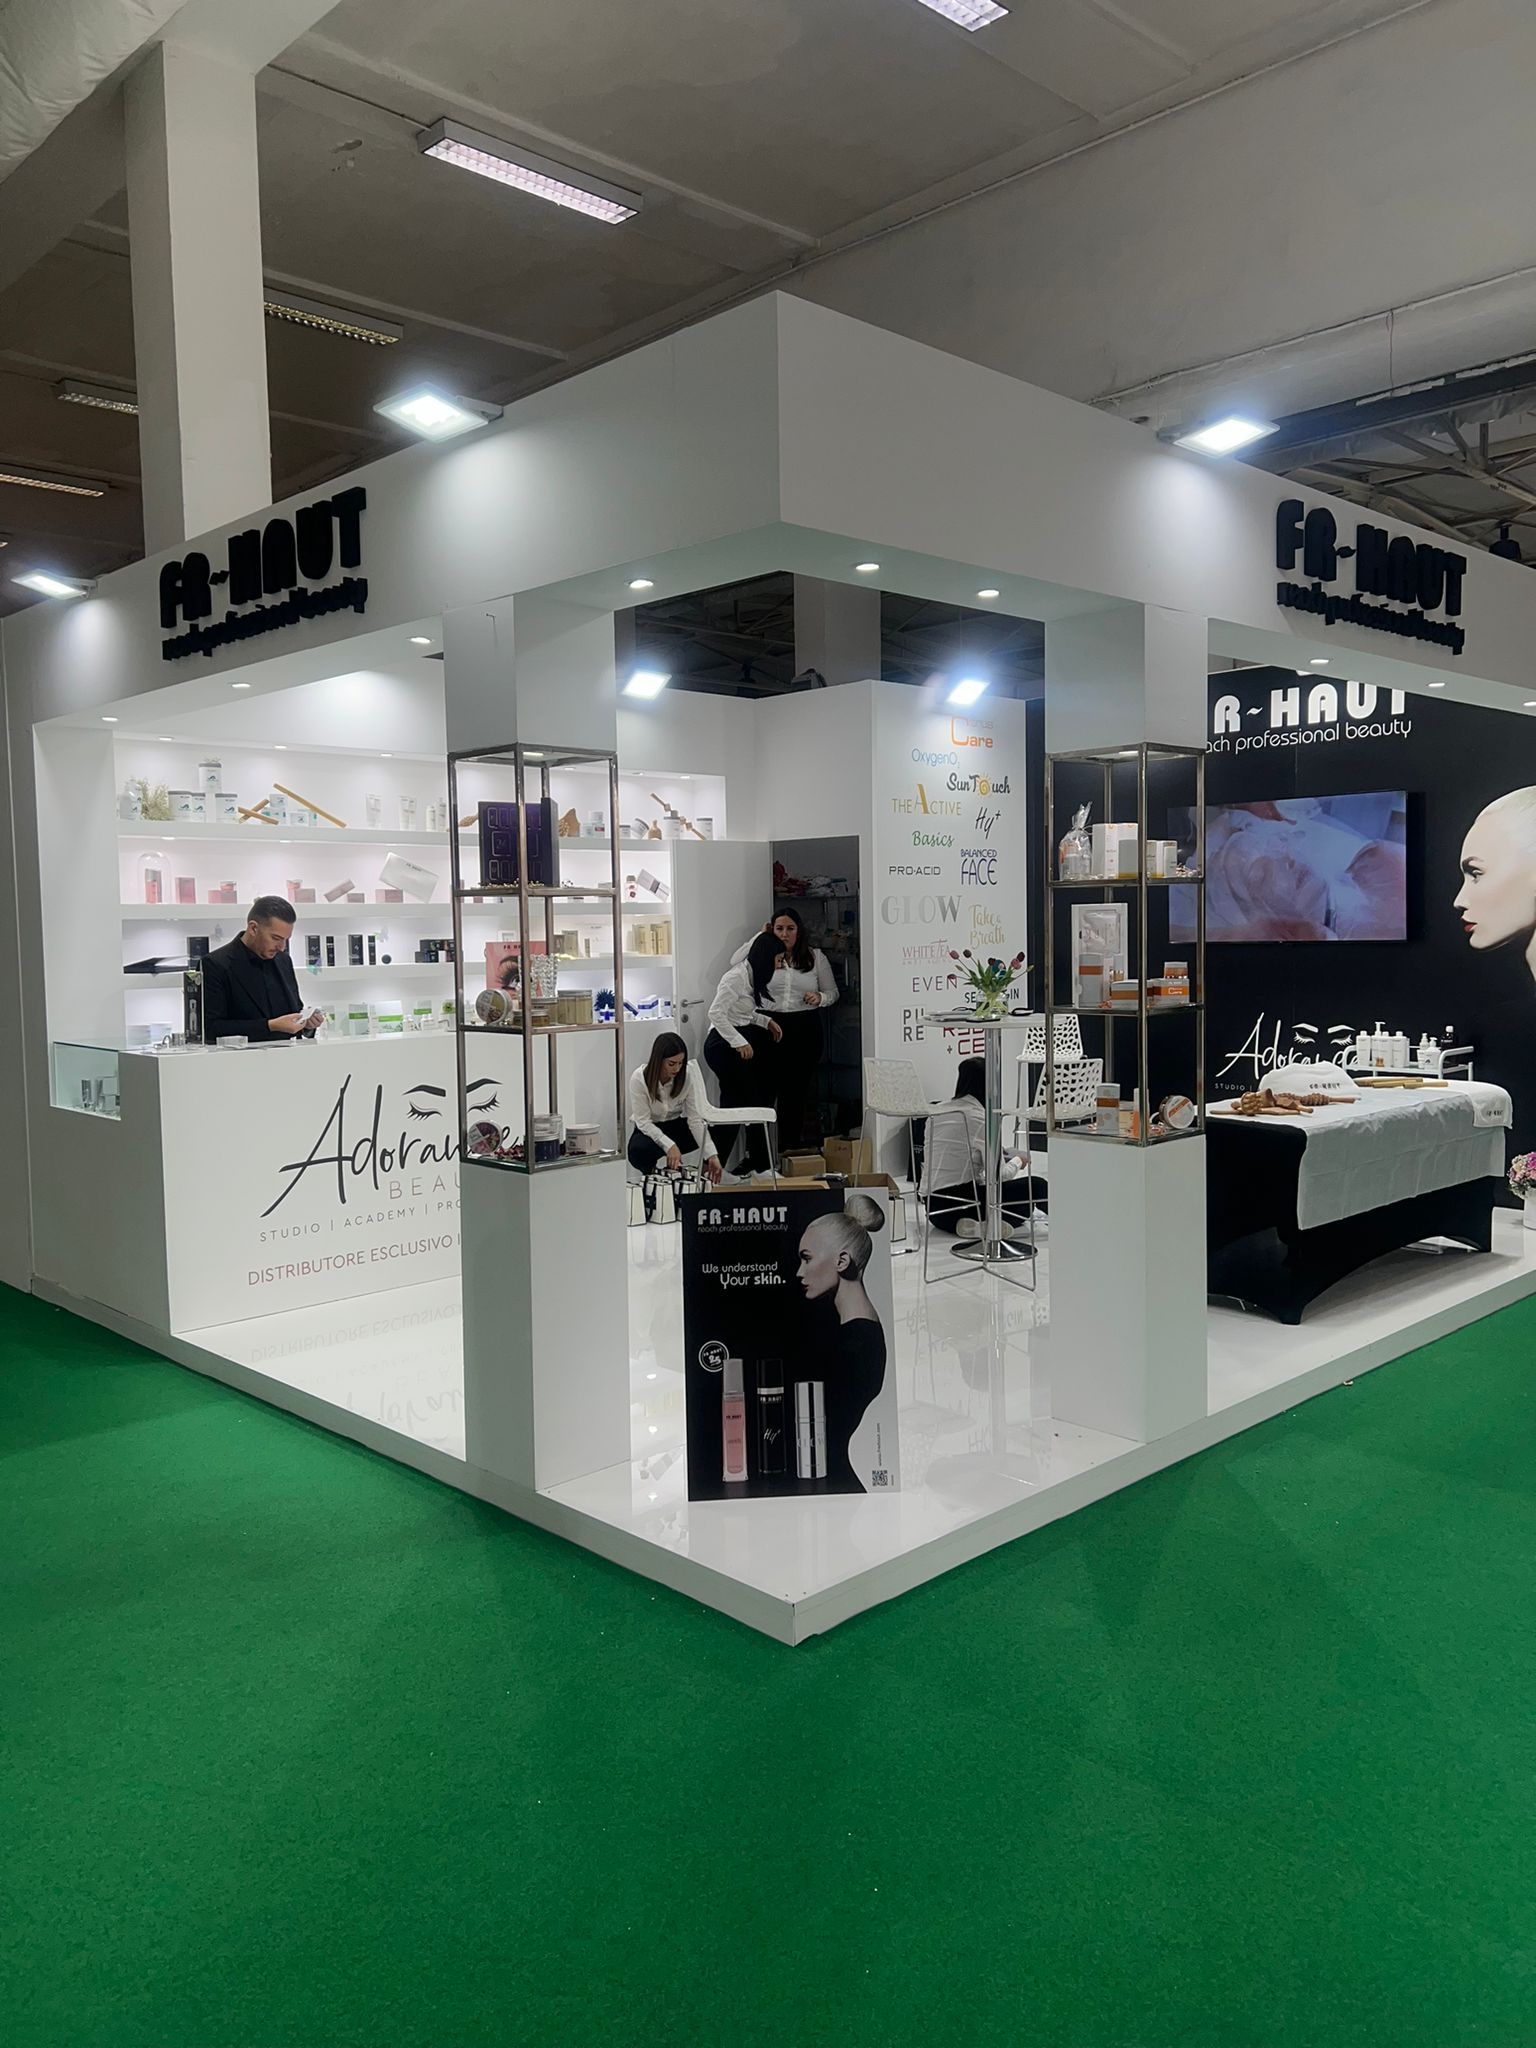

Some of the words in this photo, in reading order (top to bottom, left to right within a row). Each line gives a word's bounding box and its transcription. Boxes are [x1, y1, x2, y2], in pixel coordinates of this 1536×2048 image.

[1235, 723, 1340, 755] professional
[1345, 719, 1412, 739] beauty
[912, 830, 955, 848] Basics
[960, 849, 998, 858] BALANCED
[961, 858, 998, 886] FACE
[881, 895, 963, 925] GLOW
[968, 904, 995, 928] Take
[970, 926, 1005, 950] Breath
[912, 975, 957, 992] EVEN
[903, 1025, 925, 1042] RE
[1214, 1083, 1246, 1091] STUDIO
[260, 1222, 321, 1243] STUDIO
[344, 1207, 416, 1229] ACADEMY
[719, 1224, 762, 1234] professional
[762, 1223, 789, 1232] beauty
[248, 1250, 366, 1286] DISTRIBUTORE
[370, 1234, 454, 1263] ESCLUSIVO
[702, 1263, 719, 1274] We
[721, 1261, 778, 1273] understand
[720, 1273, 751, 1290] Your
[753, 1271, 786, 1286] skin.
